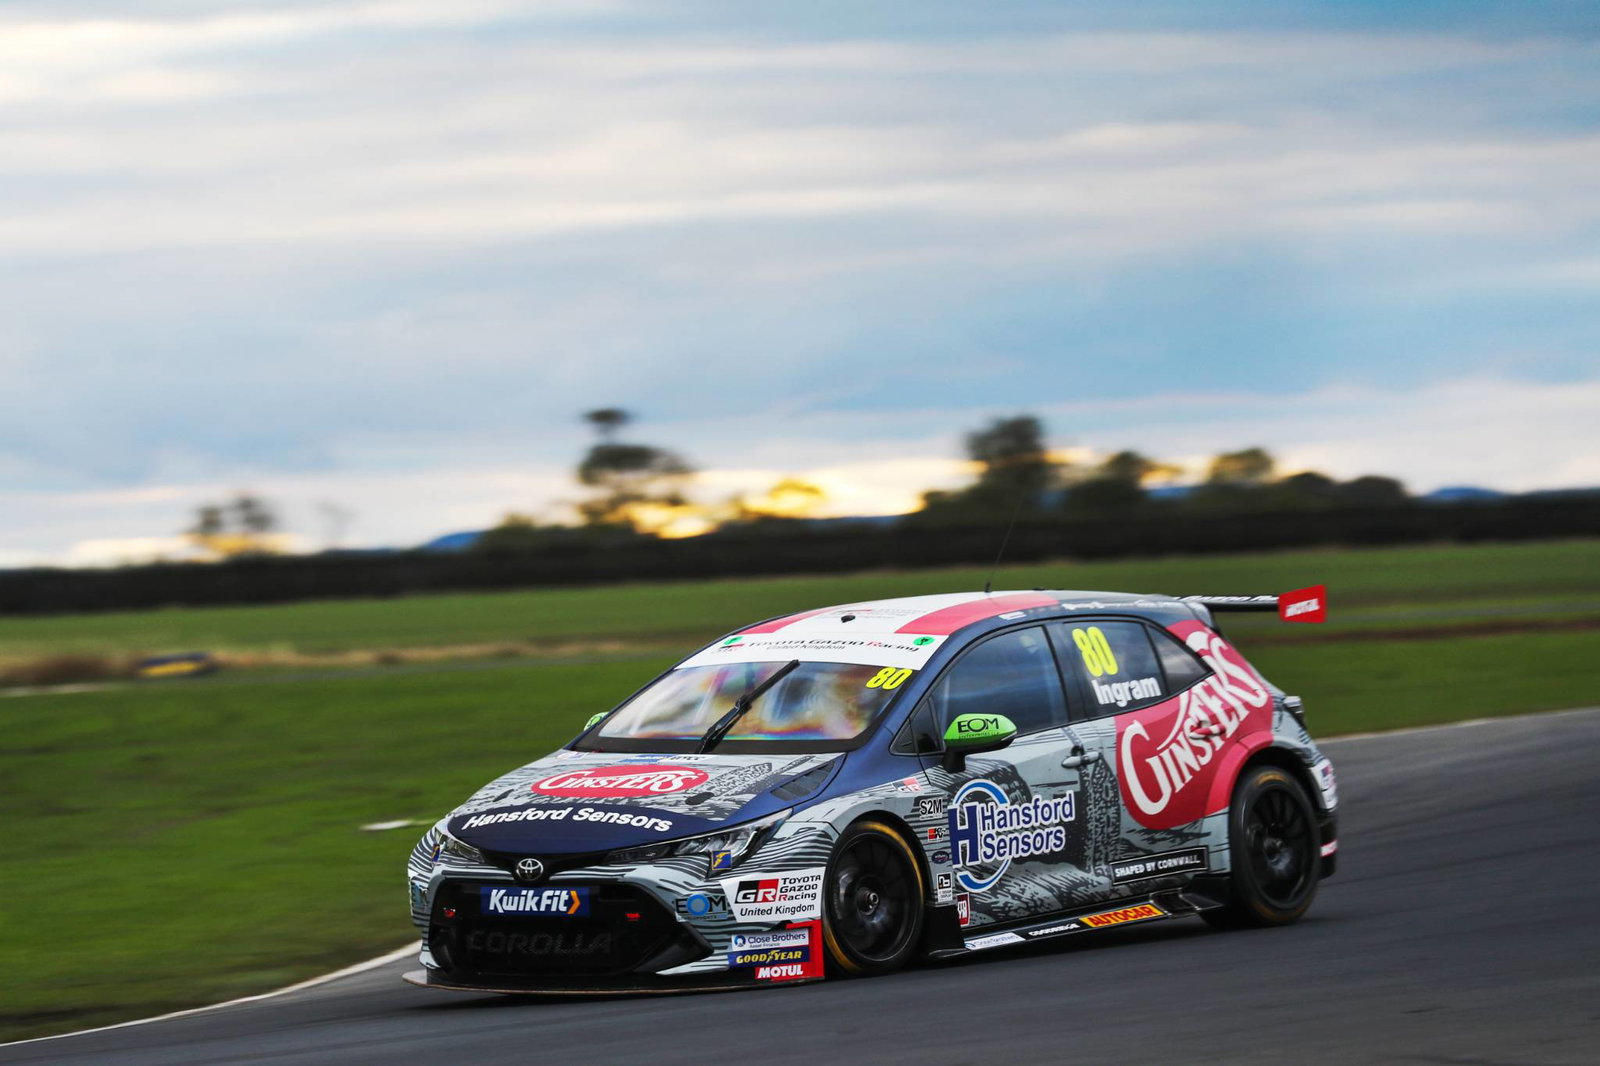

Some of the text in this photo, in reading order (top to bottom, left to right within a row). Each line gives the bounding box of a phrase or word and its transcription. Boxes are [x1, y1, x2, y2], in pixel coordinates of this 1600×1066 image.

[866, 640, 920, 652] Racing
[1072, 626, 1119, 677] 80
[866, 667, 912, 690] 80
[1092, 676, 1161, 708] Ingram
[957, 718, 999, 733] EOM
[920, 799, 943, 815] S2M
[981, 793, 1075, 832] Hansford
[461, 807, 673, 832] Hansford Sensors
[982, 828, 1065, 861] Sensors
[1114, 862, 1145, 878] SHAPED
[1145, 861, 1157, 872] BY
[781, 874, 822, 885] TOYOTA
[736, 888, 778, 904] GR
[780, 883, 818, 894] GAZOO
[779, 892, 817, 902] Racing
[740, 907, 773, 917] United
[775, 903, 815, 916] Kingdom
[1088, 904, 1158, 926] AUTOCAR
[466, 930, 612, 955] COROLLA
[748, 932, 806, 944] Close Brothers
[757, 965, 803, 979] MOTUL
